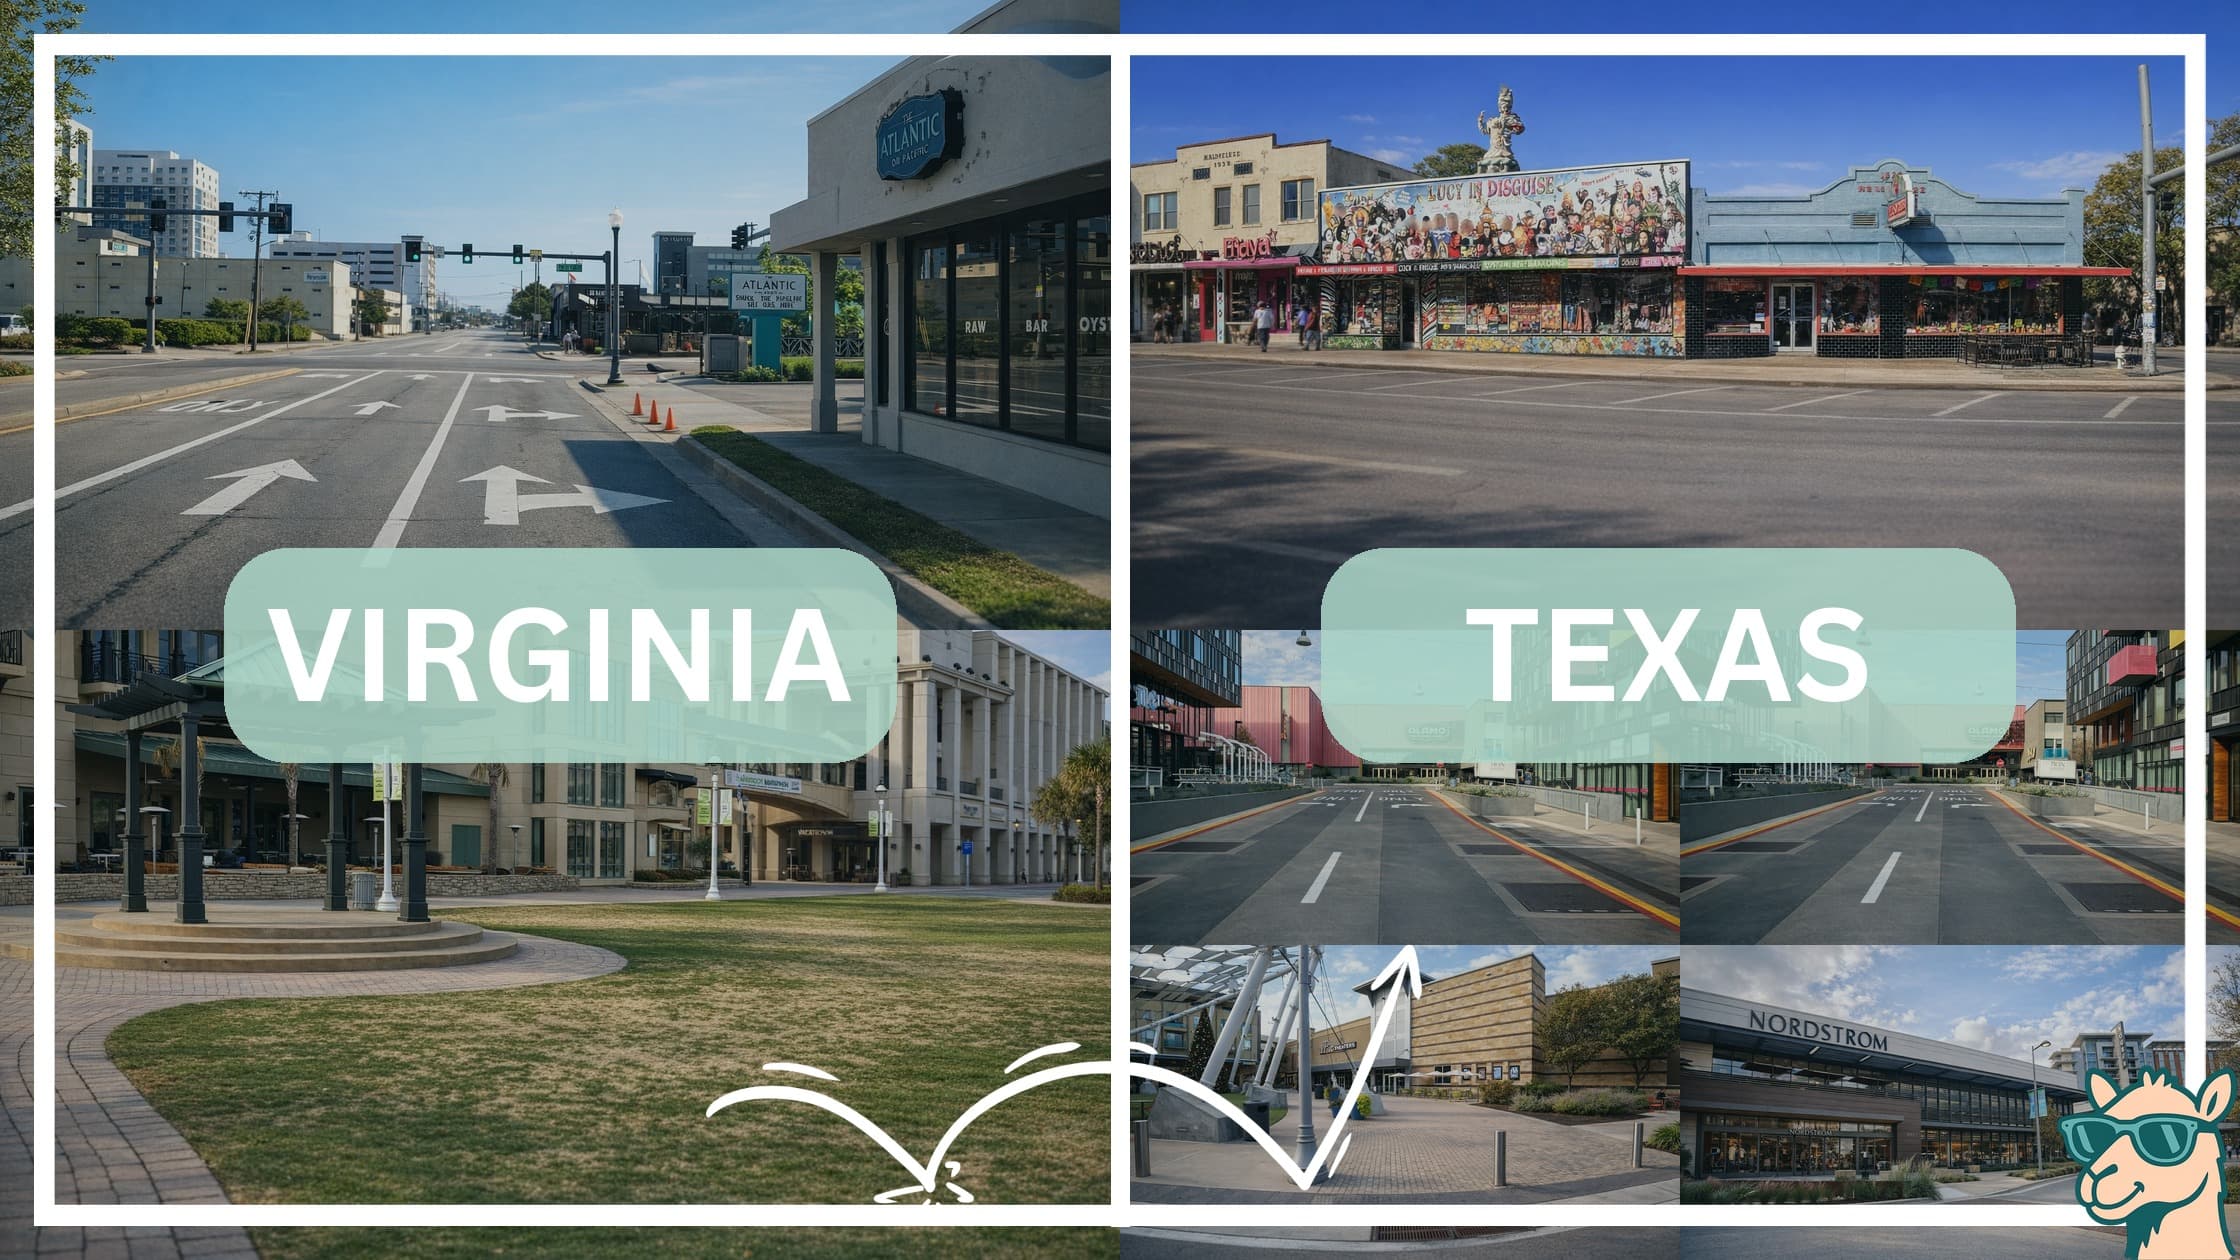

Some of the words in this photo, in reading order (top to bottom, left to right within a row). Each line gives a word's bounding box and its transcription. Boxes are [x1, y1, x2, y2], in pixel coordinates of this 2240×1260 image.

[880, 112, 940, 160] ATLANTIC
[1426, 182, 1464, 201] LUCY
[1468, 181, 1482, 199] IN
[1487, 176, 1555, 198] DISGUISE
[742, 280, 797, 290] ATLANTIC
[965, 320, 987, 334] RAW
[1025, 318, 1048, 333] BAR
[1750, 1009, 1887, 1051] NORDSTROM
